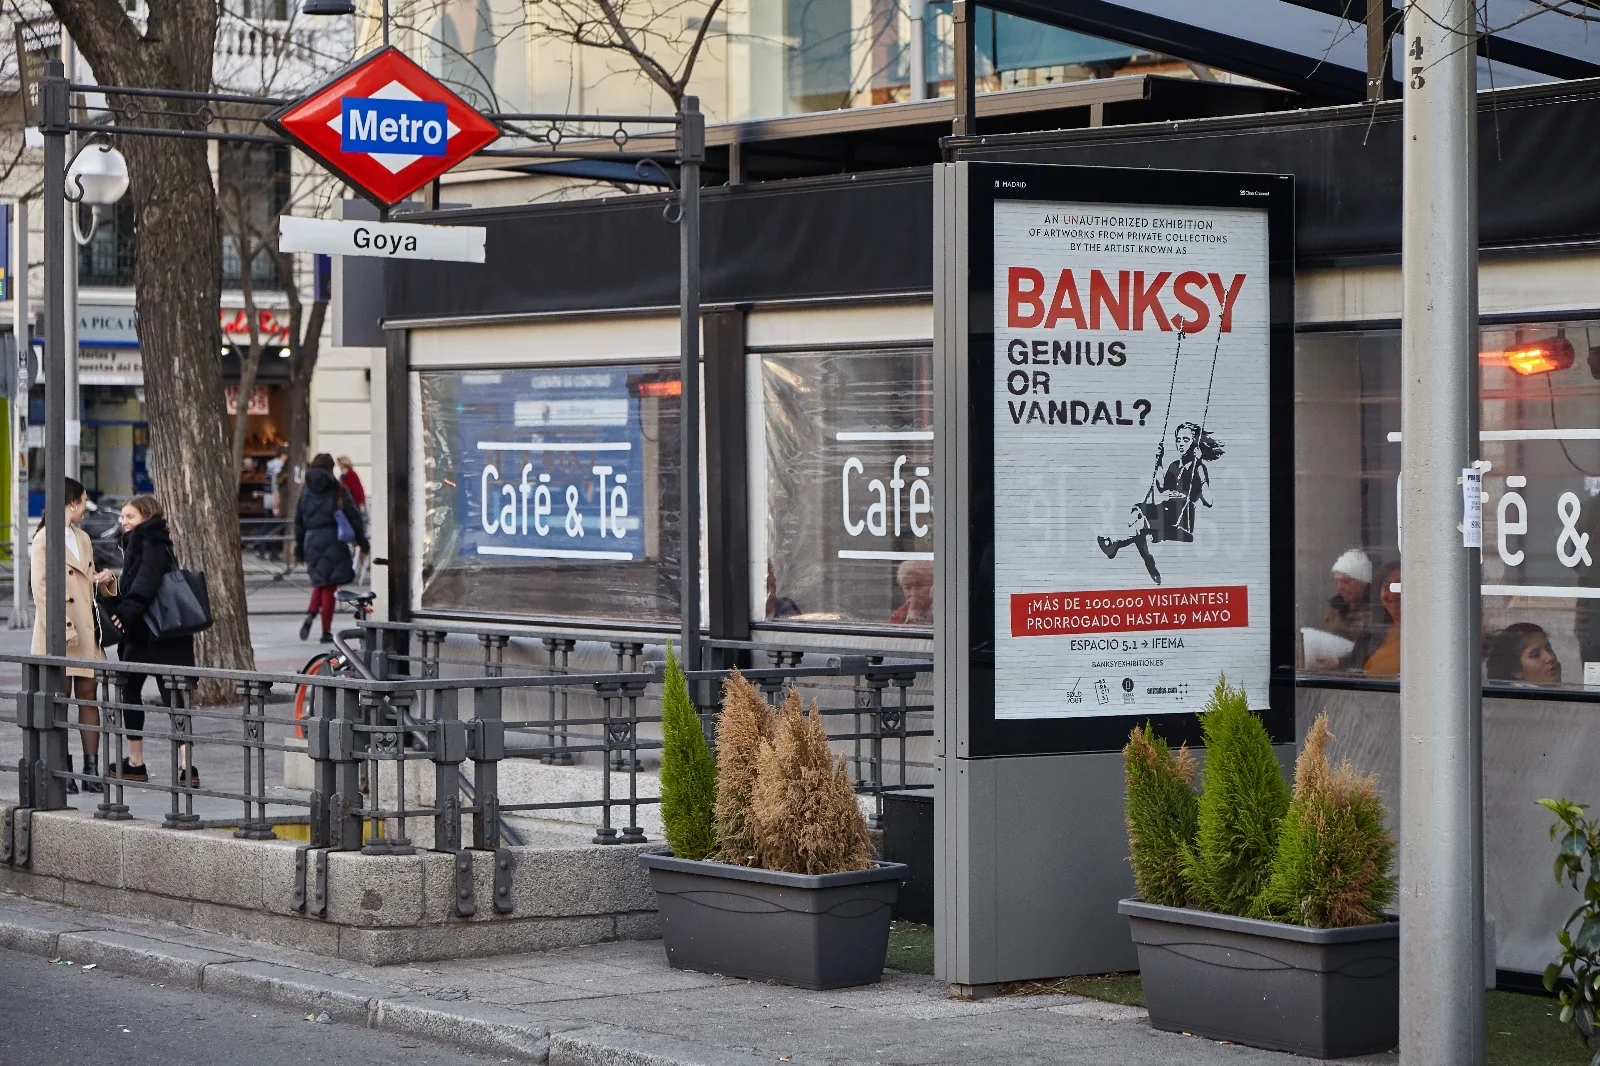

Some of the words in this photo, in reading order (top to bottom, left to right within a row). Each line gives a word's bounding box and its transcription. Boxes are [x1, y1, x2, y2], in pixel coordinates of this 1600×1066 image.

[349, 109, 442, 144] Metro
[1044, 214, 1059, 225] AN
[1063, 214, 1149, 228] UNAUTHORIZED
[1152, 218, 1213, 230] EXHIBITION
[353, 227, 417, 255] Goya
[1029, 228, 1041, 236] OF
[1043, 229, 1095, 239] ARTWORKS
[1098, 230, 1124, 240] FROM
[1127, 231, 1162, 241] PRIVATE
[1165, 233, 1228, 244] COLLECTIONS
[1070, 242, 1082, 251] BY
[1084, 243, 1101, 252] THE
[1104, 244, 1136, 253] ARTIST
[1138, 245, 1173, 254] KNOWN
[1175, 246, 1187, 255] AS
[1007, 266, 1247, 334] BANKSY
[91, 316, 124, 331] PICA
[1007, 338, 1127, 367] GENIUS
[1007, 370, 1051, 395] OR
[1007, 399, 1152, 426] VANDAL?
[565, 491, 585, 538] &
[1556, 491, 1593, 568] &
[1028, 595, 1060, 614] ¡MÁS
[1064, 598, 1081, 611] DE
[1085, 597, 1144, 610] 100.000
[1148, 592, 1230, 608] VISITANTES!
[1027, 614, 1121, 630] PRORROGADO
[1126, 612, 1169, 626] HASTA
[1173, 613, 1187, 626] 19
[1192, 610, 1231, 623] MAYO
[1070, 638, 1119, 651] ESPACIO
[1122, 640, 1138, 652] 5.1
[1152, 637, 1185, 649] IFEMA
[1091, 659, 1164, 669] BANKSYEXHIBITION.ES
